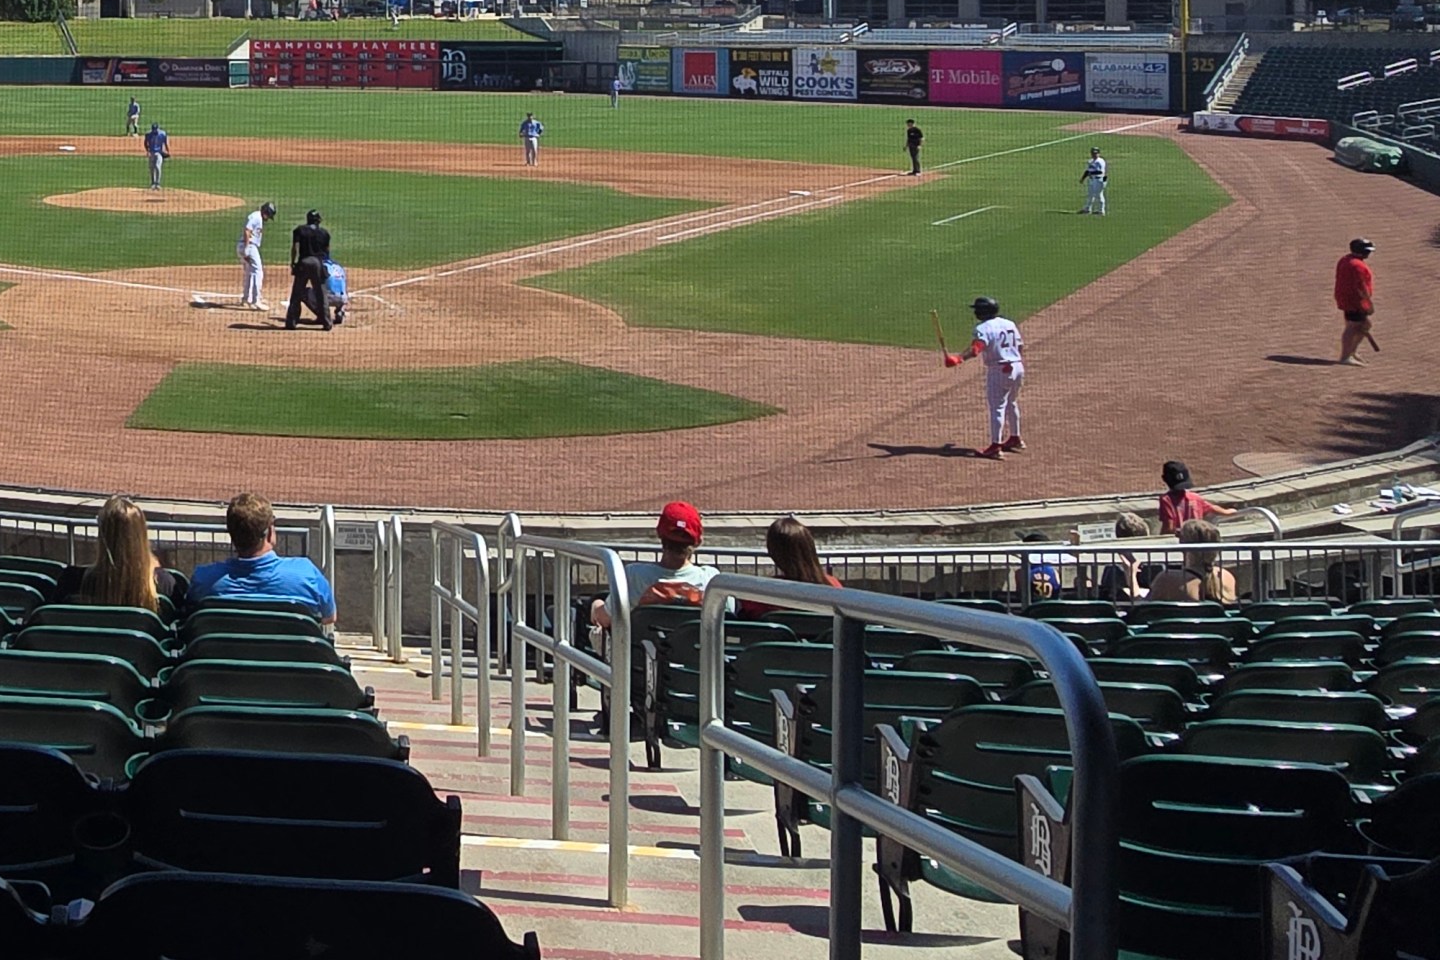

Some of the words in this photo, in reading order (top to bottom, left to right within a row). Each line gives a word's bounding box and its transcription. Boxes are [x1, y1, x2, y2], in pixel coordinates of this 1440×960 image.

[254, 41, 343, 50] CHAMPIONS
[353, 41, 389, 50] PLAY
[399, 41, 436, 50] HERE
[1144, 63, 1166, 73] 42
[1191, 57, 1215, 72] 325
[759, 69, 789, 77] BUFFALO
[948, 68, 1000, 86] Mobile
[760, 76, 789, 87] WILD
[795, 76, 855, 90] COOK'S
[1092, 78, 1131, 88] LOCAL
[760, 86, 789, 96] WINGS
[815, 89, 854, 97] CONTROL
[1091, 87, 1164, 96] COVERAGE
[1000, 329, 1016, 348] 27
[1032, 581, 1053, 599] 30
